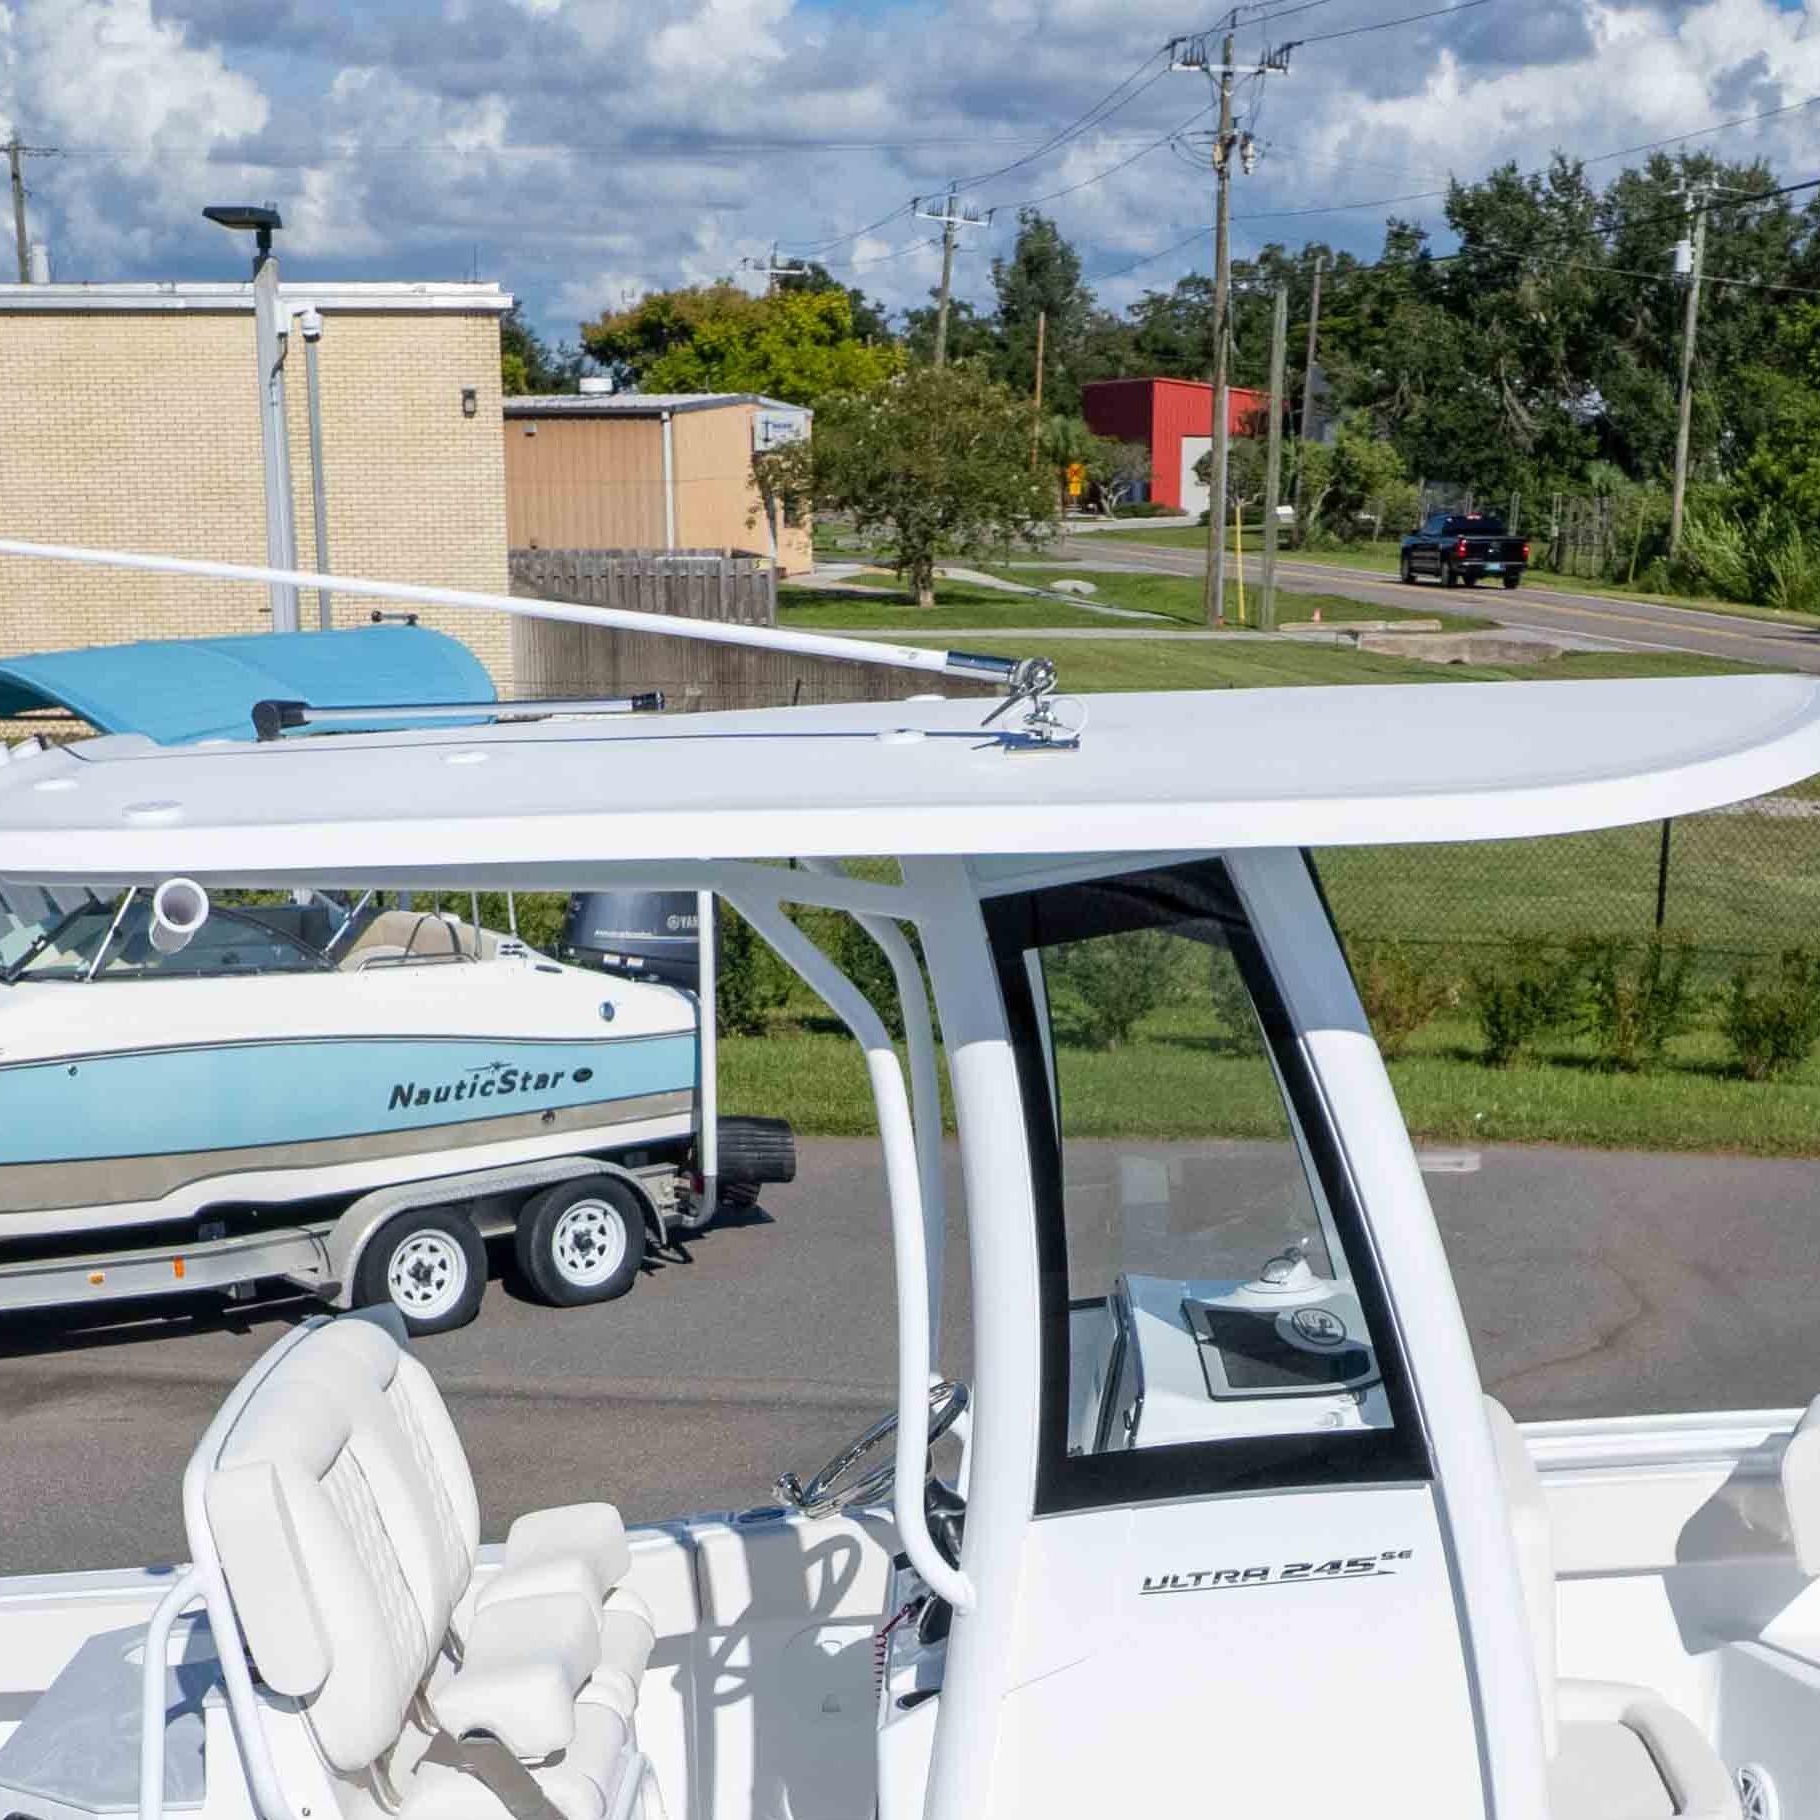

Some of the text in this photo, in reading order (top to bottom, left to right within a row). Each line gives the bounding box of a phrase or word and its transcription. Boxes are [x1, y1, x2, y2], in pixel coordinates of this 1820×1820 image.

[388, 1068, 565, 1111] NauticStar
[1142, 1566, 1271, 1591] ULTRA
[1280, 1556, 1377, 1580] 245
